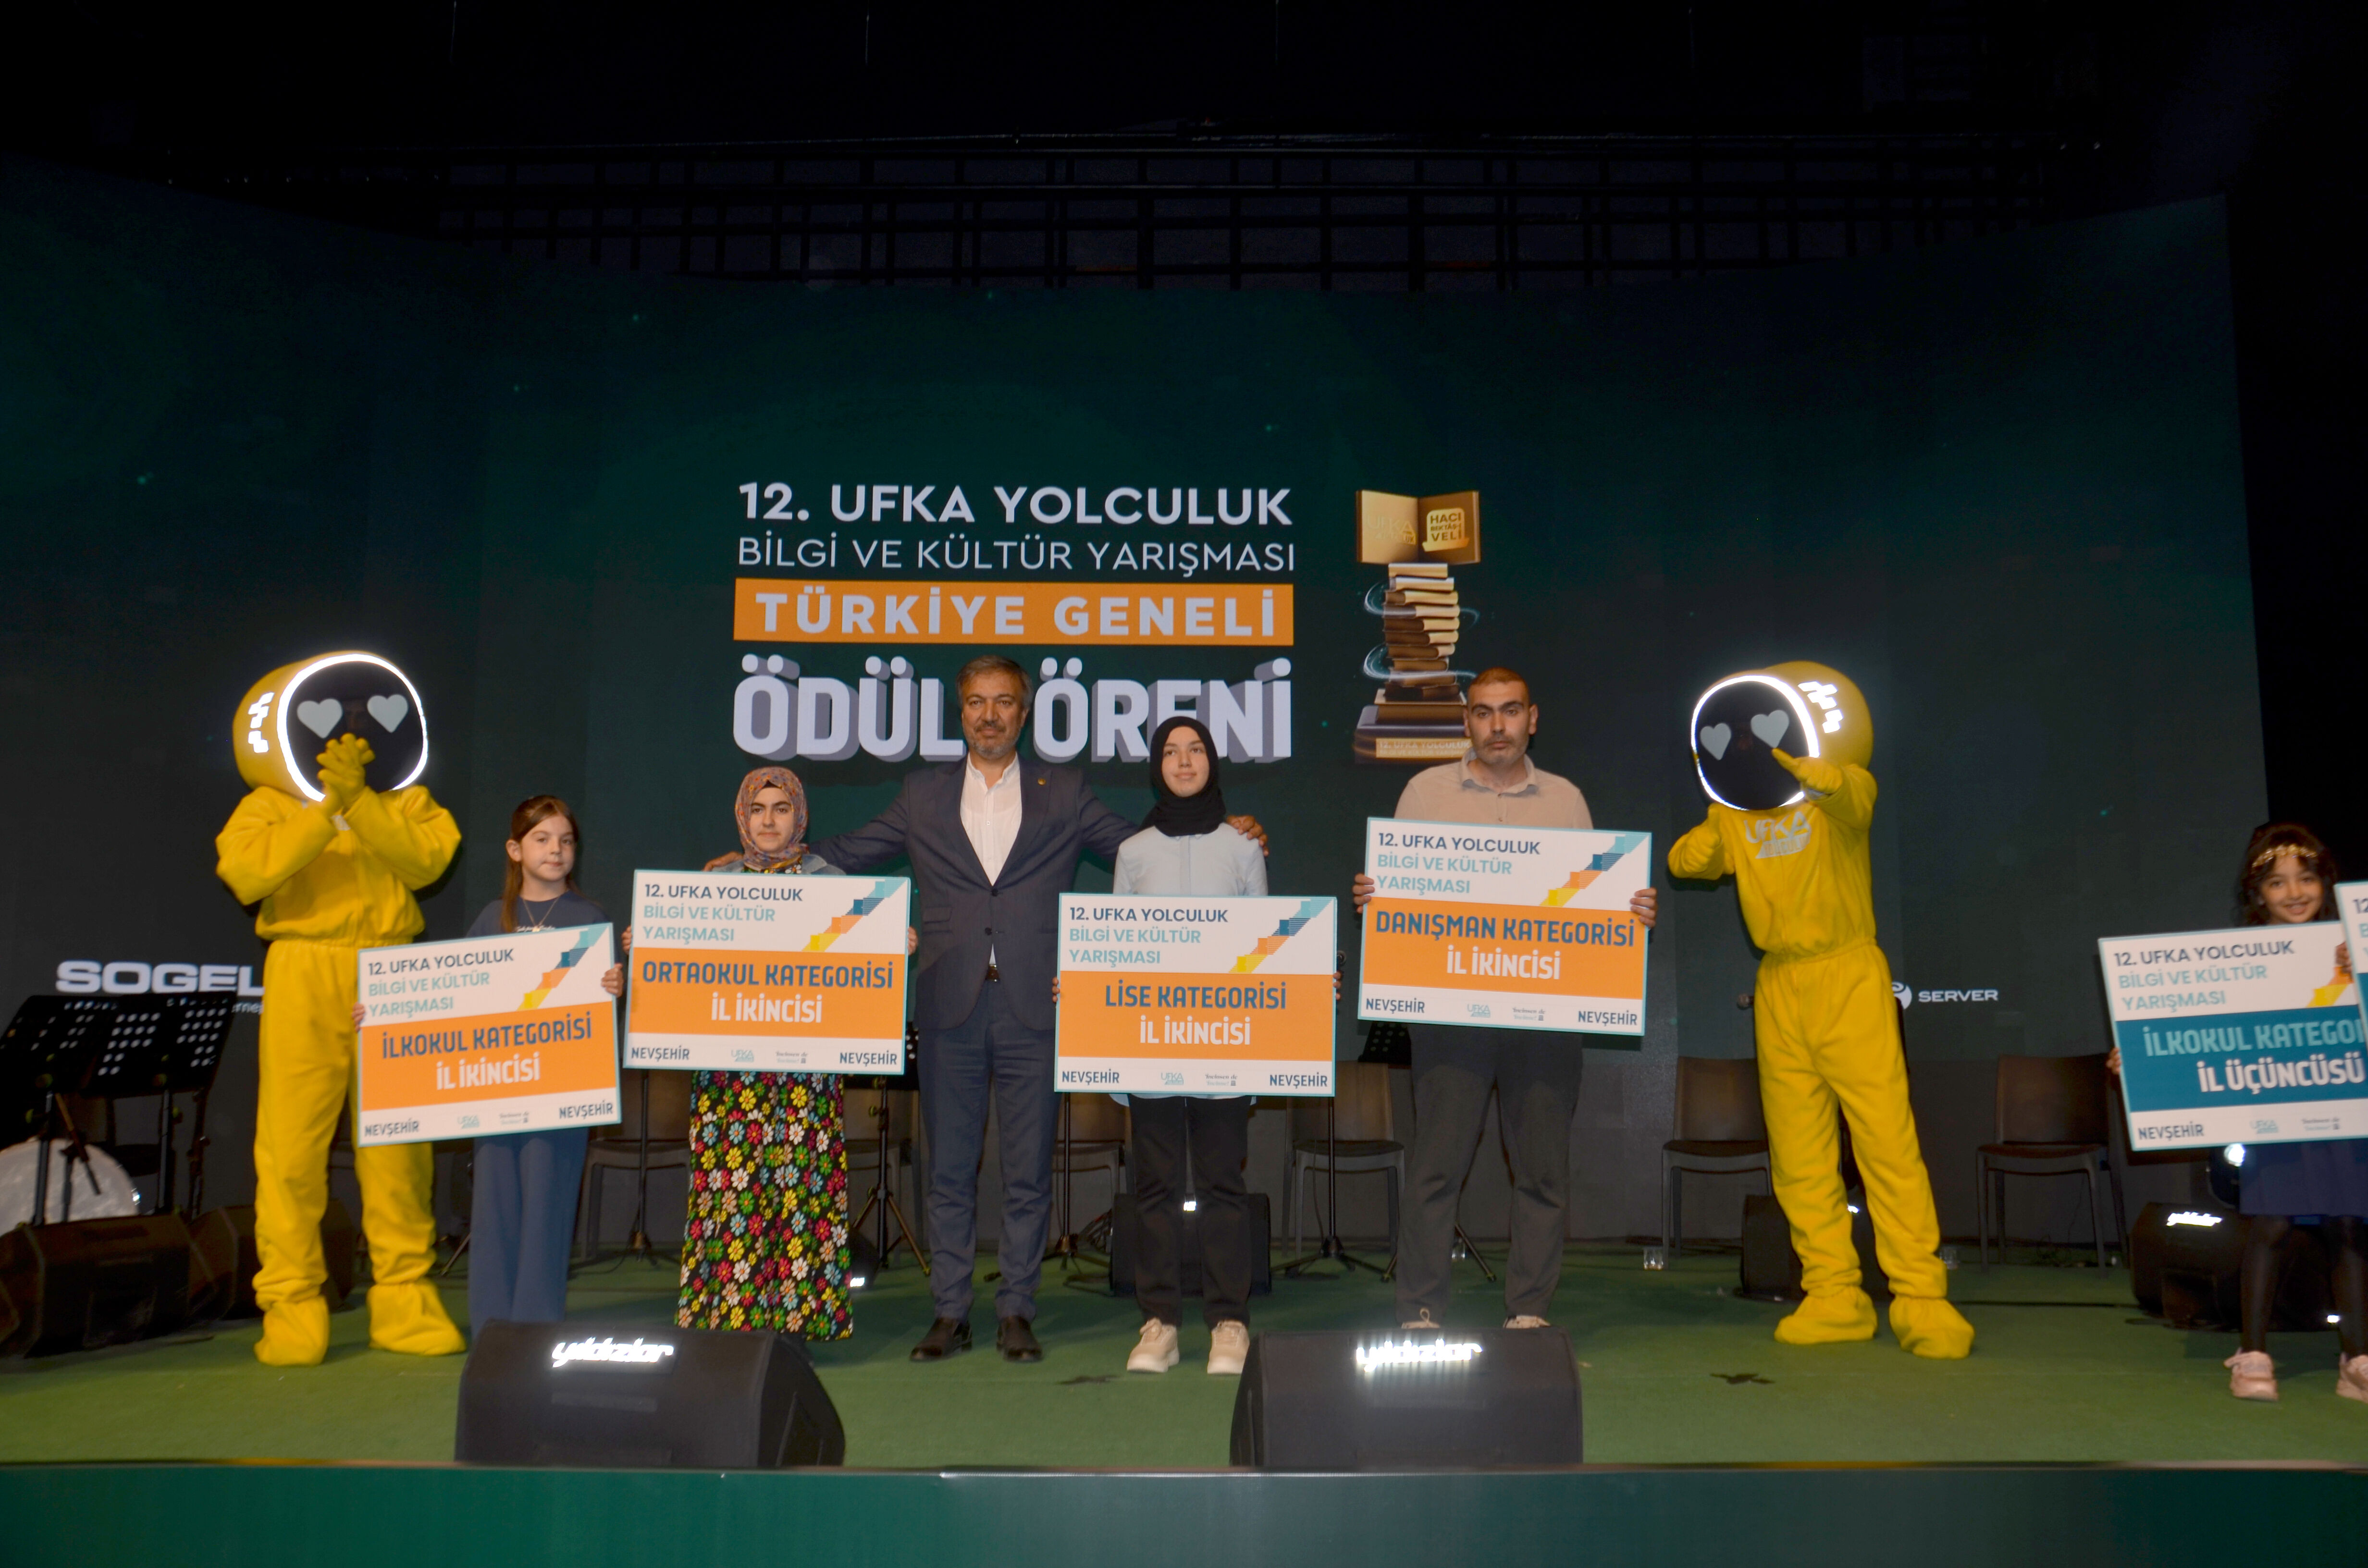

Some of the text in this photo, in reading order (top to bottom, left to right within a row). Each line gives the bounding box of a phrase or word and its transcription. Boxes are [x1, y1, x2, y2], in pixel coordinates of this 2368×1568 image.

[739, 482, 1292, 526] 12. UFKA YOLCULUK
[1431, 512, 1462, 524] HACI
[739, 530, 1294, 578] BİLGİ VE KÜLTÜR YARIŞMASI
[755, 585, 1274, 637] TÜRKİYE GENELİ
[733, 653, 963, 758] ÖDÜL
[1744, 811, 1811, 843] UFKA
[1379, 833, 1541, 855] 12. UFKA YOLCULUK
[1378, 851, 1512, 875] BİLGİ VE KÜLTÜR
[645, 884, 803, 901] 12. UFKA YOLCULUK
[1376, 875, 1470, 896] YARIŞMASI
[643, 902, 776, 922] BİLGİ VE KÜLTÜR
[1070, 907, 1228, 922] 12. UFKA YOLCULUK
[642, 926, 734, 945] YARIŞMASI
[1070, 925, 1201, 943] BİLGİ VE KÜLTÜR
[1376, 911, 1635, 947] DANIŞMAN KATEGORİSİ
[368, 948, 514, 976] 12. UFKA YOLCULUK
[1069, 949, 1160, 968] YARIŞMASI
[1447, 944, 1561, 980] İL İKİNCİSİ
[2114, 940, 2294, 967] 12. UFKA YOLCULUK
[369, 969, 490, 997] BİLGİ VE KÜLTÜR
[642, 960, 893, 989] ORTAOKUL KATEGORİSİ
[2118, 965, 2268, 989] BİLGİ VE KÜLTÜR
[1106, 979, 1286, 1009] LİSE KATEGORİSİ
[1366, 997, 1425, 1014] NEVŞEHİR
[1918, 989, 1998, 1003] SERVER
[2121, 990, 2226, 1013] YARIŞMASI
[369, 996, 454, 1019] YARIŞMASI
[711, 991, 823, 1023] İL İKİNCİSİ
[1578, 1010, 1638, 1027] NEVŞEHİR
[383, 1011, 592, 1059] İLKOKUL KATEGORİSİ
[1140, 1015, 1251, 1045] İL İKİNCİSİ
[2142, 1026, 2252, 1057] İLKOKUL
[631, 1045, 690, 1062] NEVŞEHİR
[839, 1050, 897, 1067] NEVŞEHİR
[436, 1051, 541, 1090] İL İKİNCİSİ
[1062, 1068, 1120, 1086] NEVŞEHİR
[1161, 1072, 1184, 1081] UFKA
[1270, 1072, 1328, 1089] NEVŞEHİR
[2196, 1052, 2365, 1095] İL ÜÇÜNCÜSÜ
[559, 1100, 613, 1119] NEVŞEHİR
[364, 1118, 419, 1137] NEVŞEHİR
[2138, 1121, 2205, 1141] NEVŞEHİR
